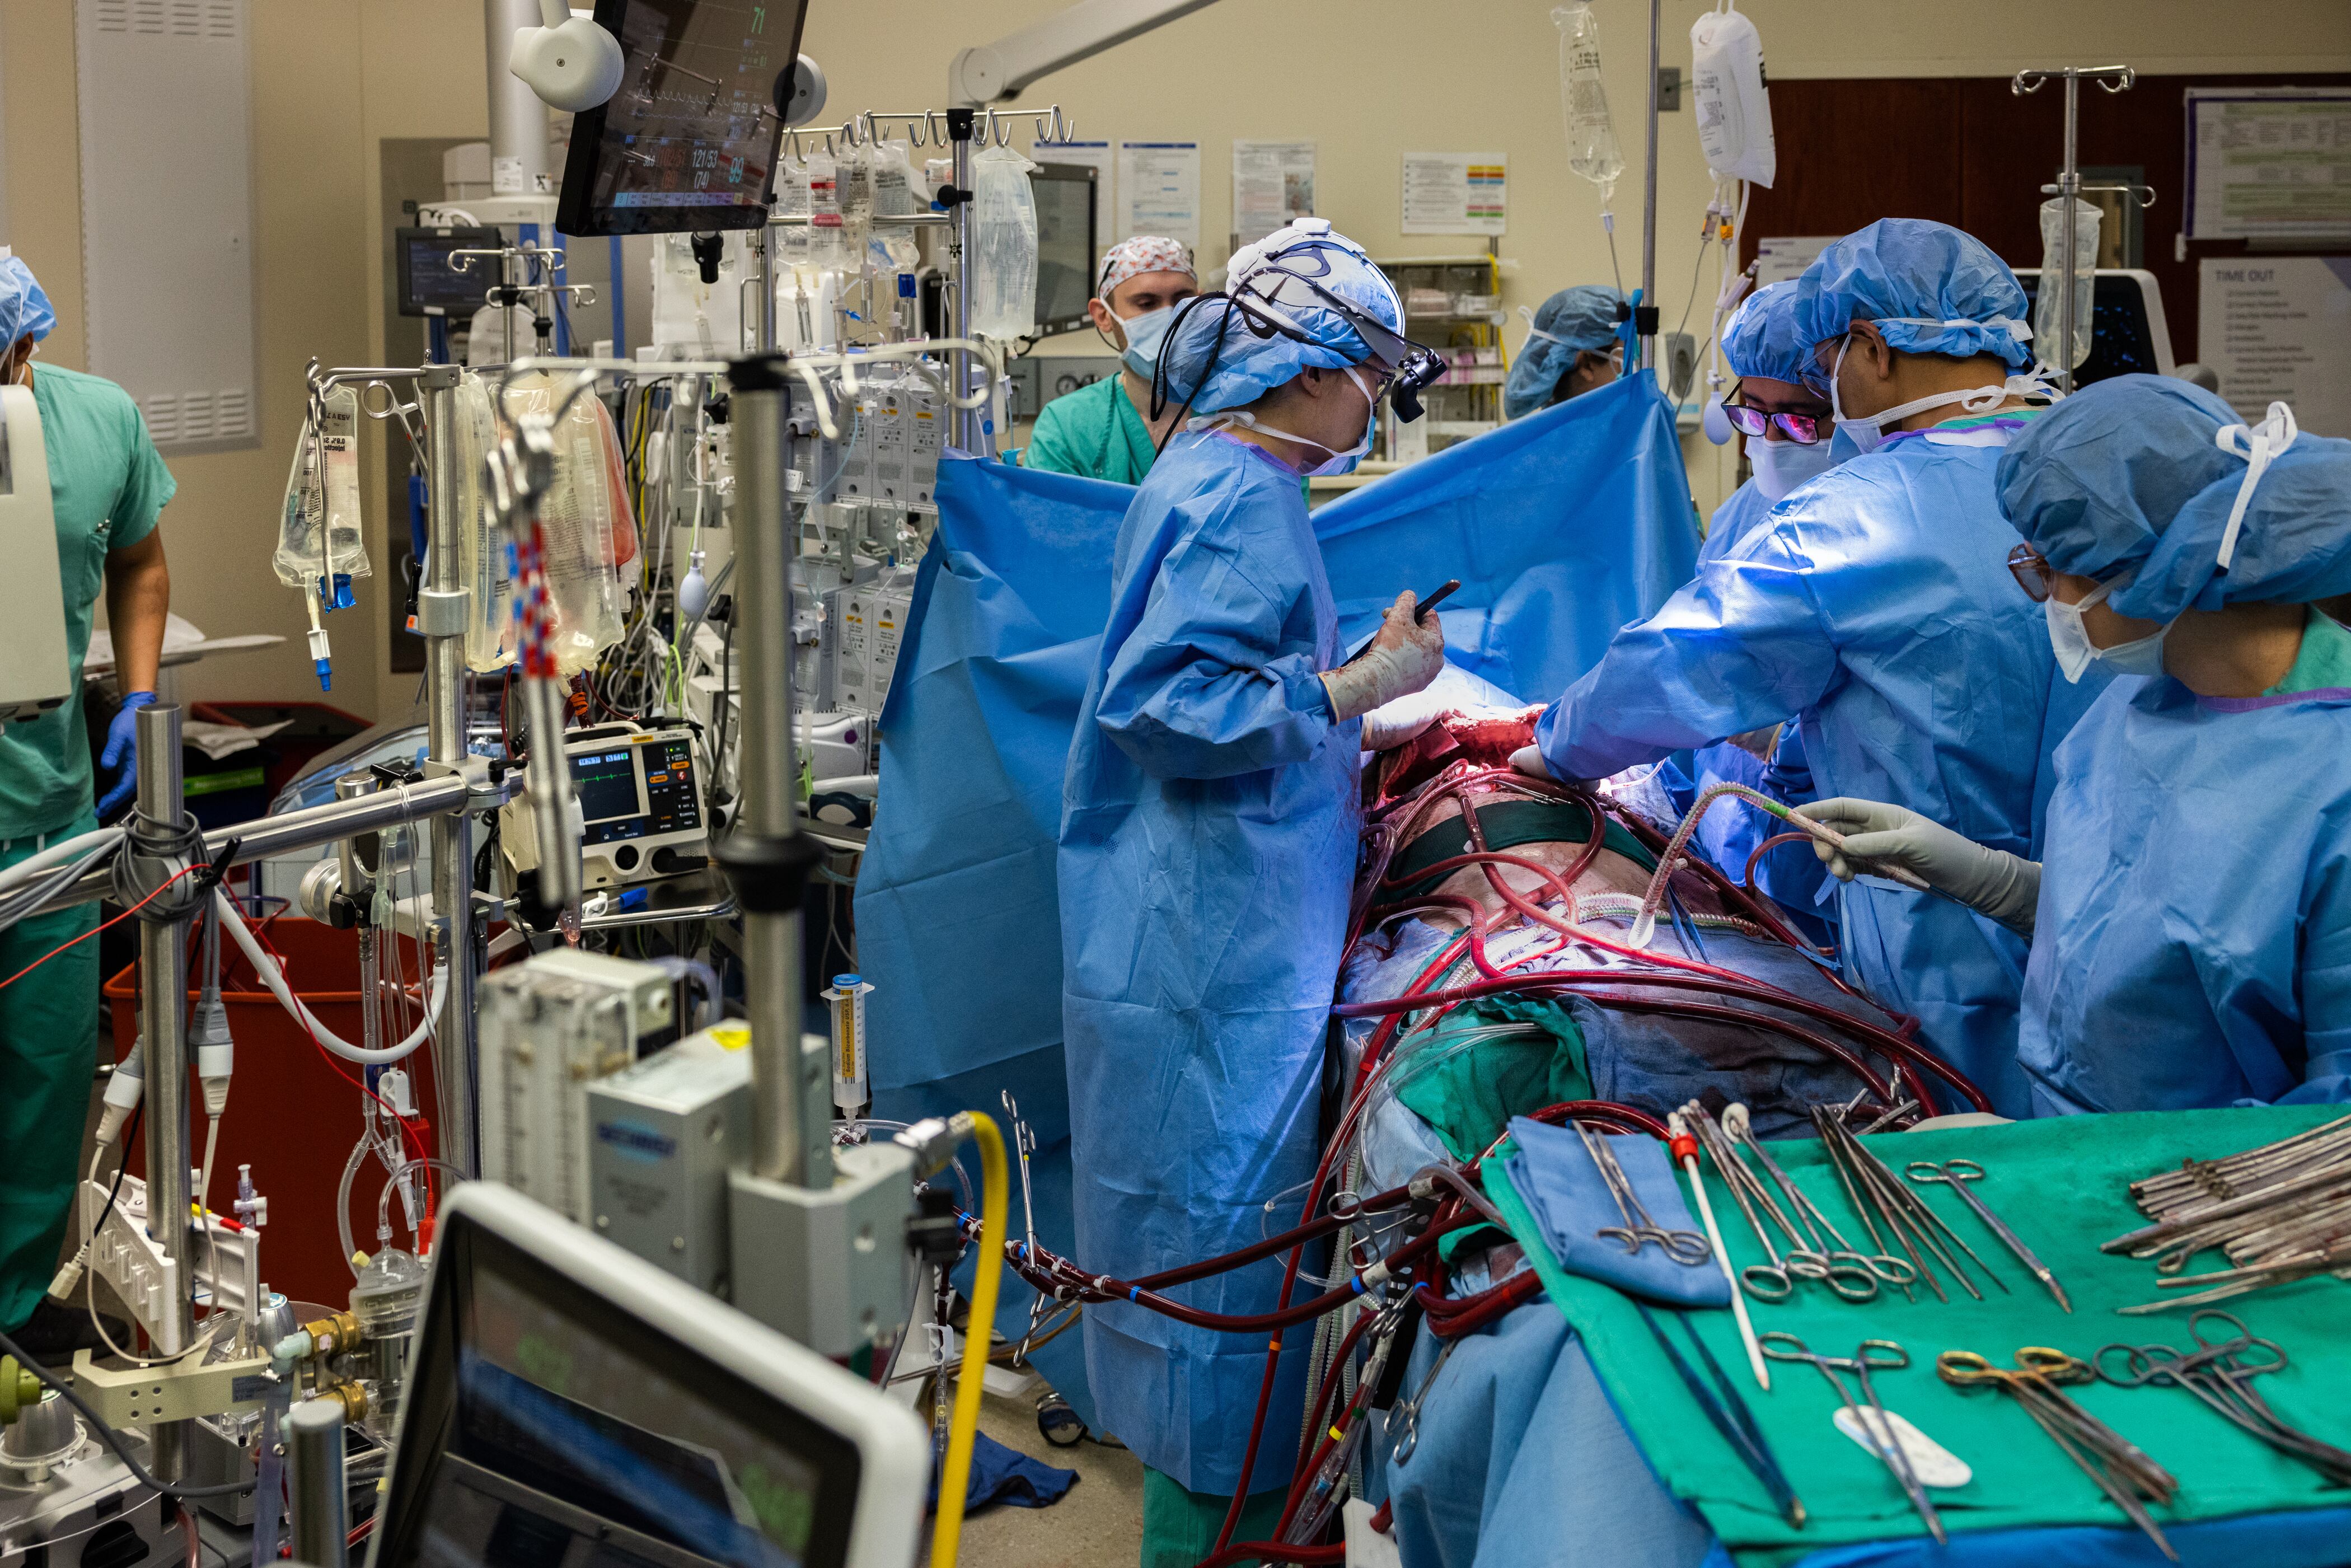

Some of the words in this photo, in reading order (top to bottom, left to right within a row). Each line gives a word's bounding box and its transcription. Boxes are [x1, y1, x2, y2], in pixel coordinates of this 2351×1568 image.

[692, 149, 718, 168] 121/53
[729, 156, 743, 184] 99
[694, 171, 709, 189] (74)
[2216, 269, 2245, 282] TIME
[2248, 269, 2274, 282] OUT
